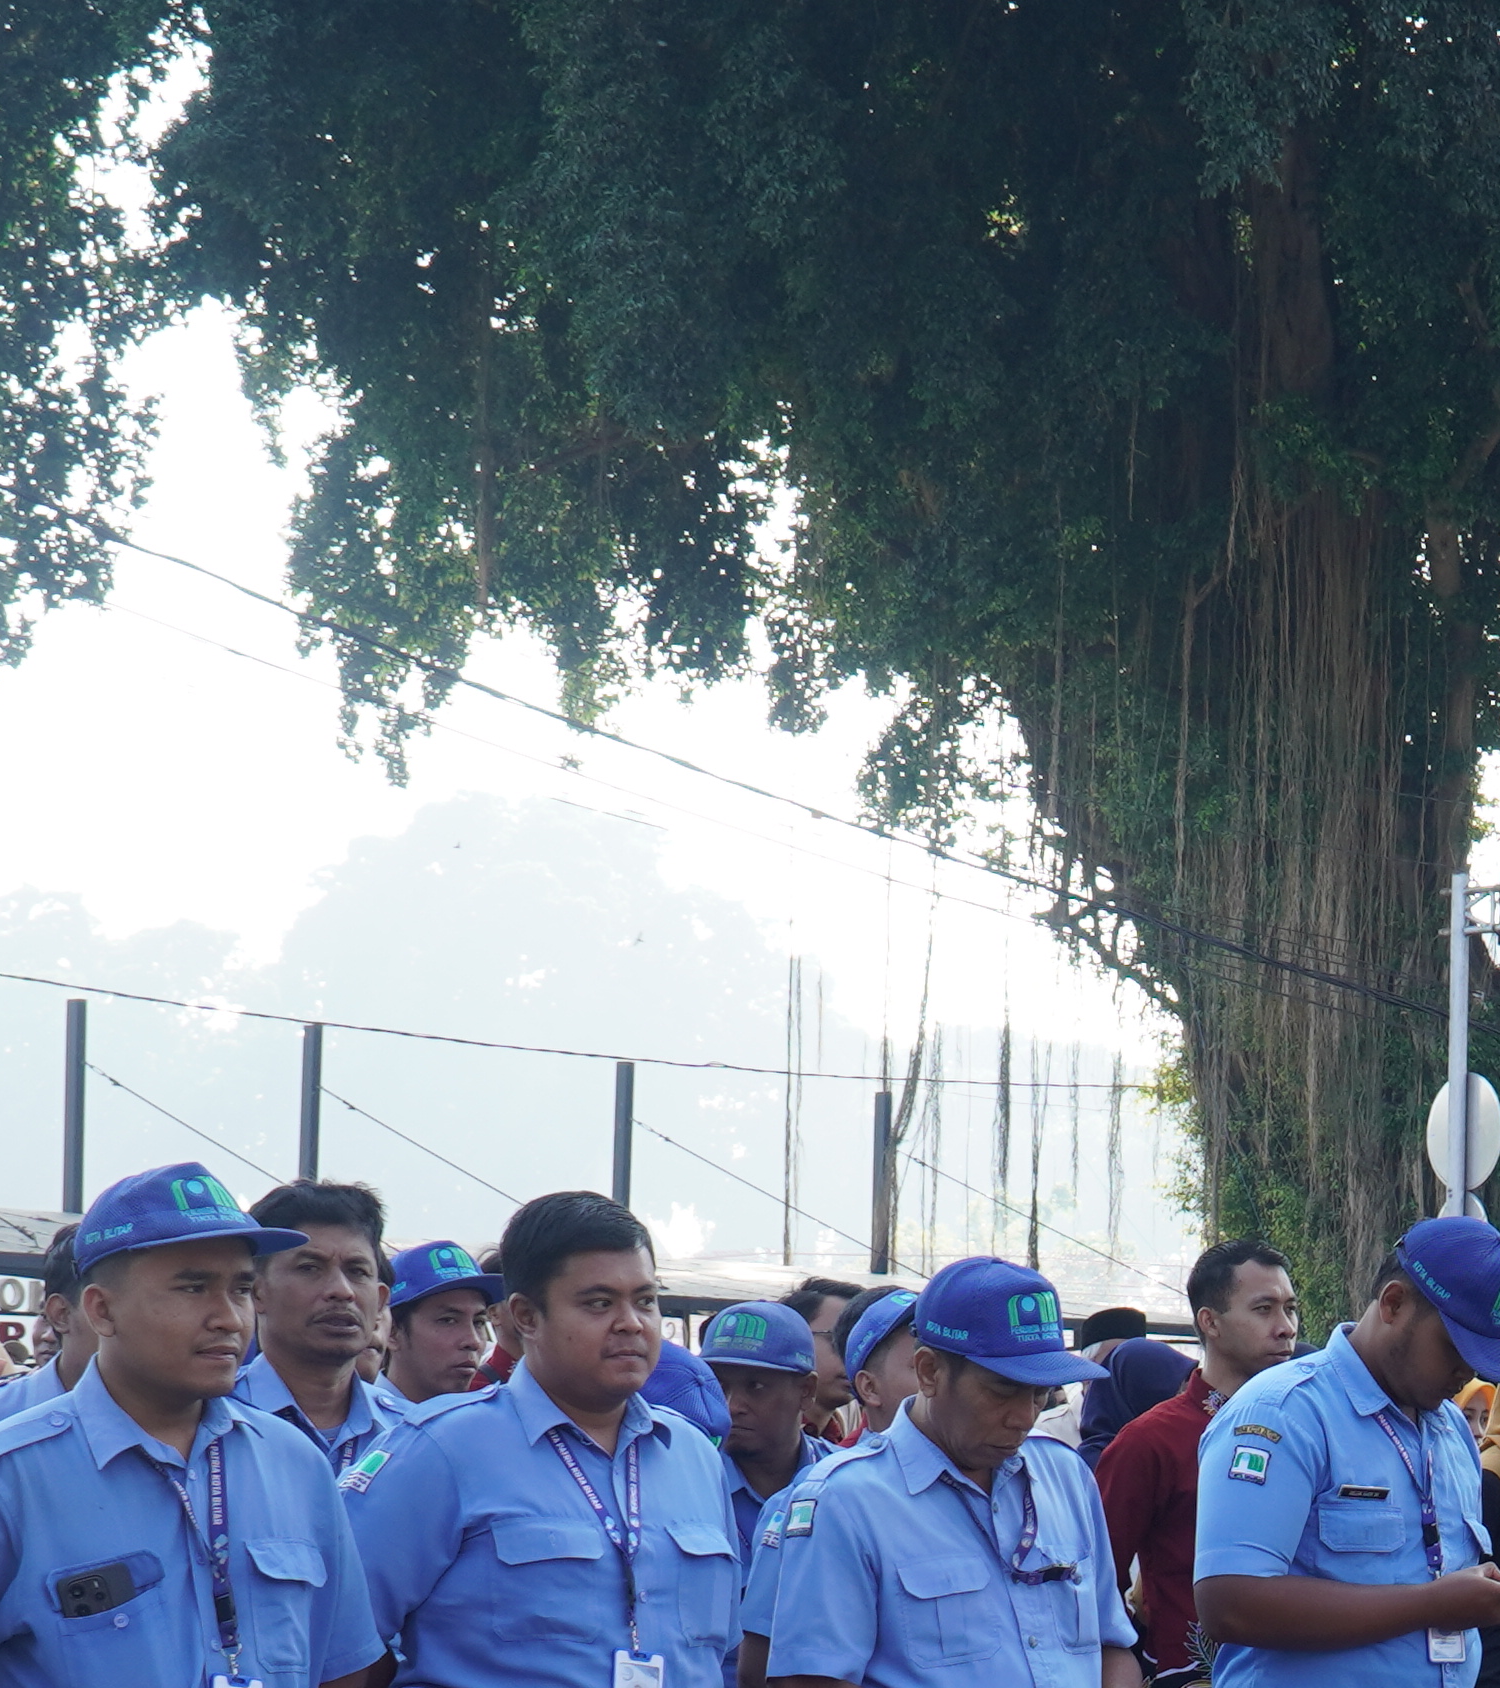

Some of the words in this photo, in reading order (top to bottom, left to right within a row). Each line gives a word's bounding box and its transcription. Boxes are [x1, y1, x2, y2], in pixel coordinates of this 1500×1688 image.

[1411, 1260, 1428, 1281] KOTA
[1425, 1276, 1452, 1300] BLITAR
[942, 1325, 969, 1341] BLITAR
[210, 1474, 222, 1496] KOTA
[571, 1466, 588, 1486] KOTA
[582, 1484, 603, 1510] BLITAR
[211, 1496, 223, 1526] BLITAR
